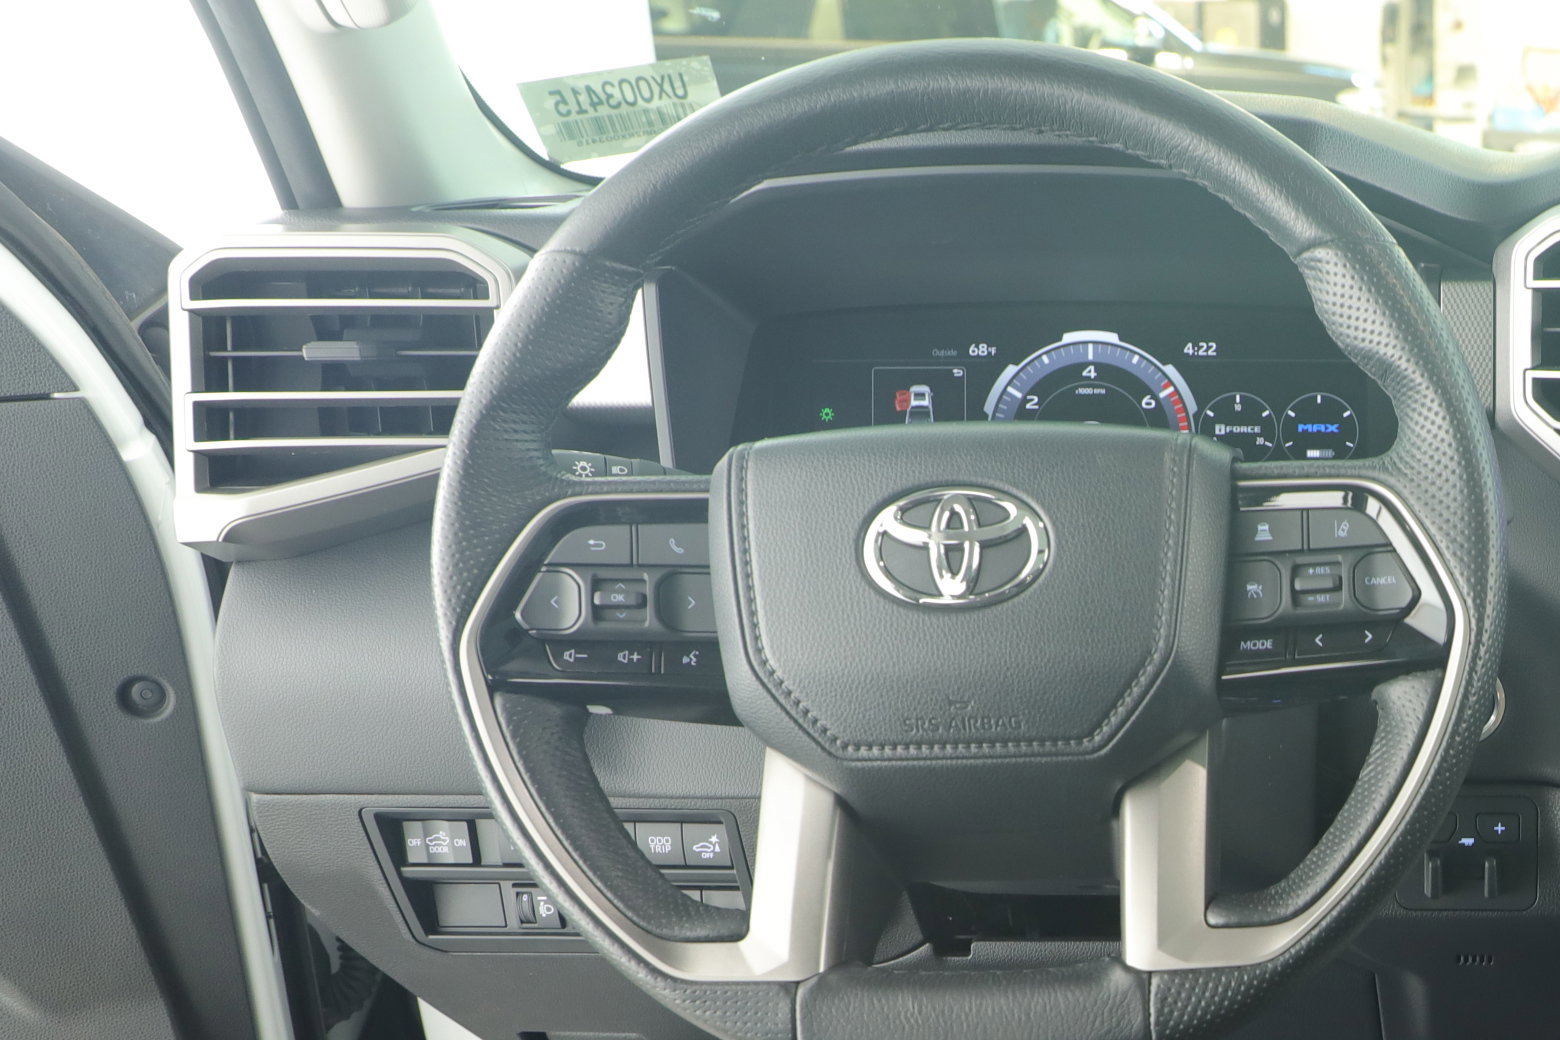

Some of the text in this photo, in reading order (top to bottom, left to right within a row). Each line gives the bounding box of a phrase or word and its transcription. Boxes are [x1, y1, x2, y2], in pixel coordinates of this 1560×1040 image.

[932, 347, 958, 357] Outside
[1183, 343, 1217, 356] 4:22
[1082, 365, 1097, 379] 4
[1025, 395, 1039, 409] 2
[1142, 395, 1155, 409] 6
[1234, 403, 1242, 412] 10
[1297, 423, 1340, 433] MAX
[1256, 437, 1264, 446] 20
[1365, 576, 1397, 585] CANCEL
[611, 593, 625, 602] OK
[1240, 639, 1273, 650] MODE
[901, 715, 1024, 734] SRS AIRBAG
[407, 838, 421, 847] OFF
[453, 838, 466, 847] ON
[648, 836, 672, 845] ODO
[649, 844, 672, 854] TRIP
